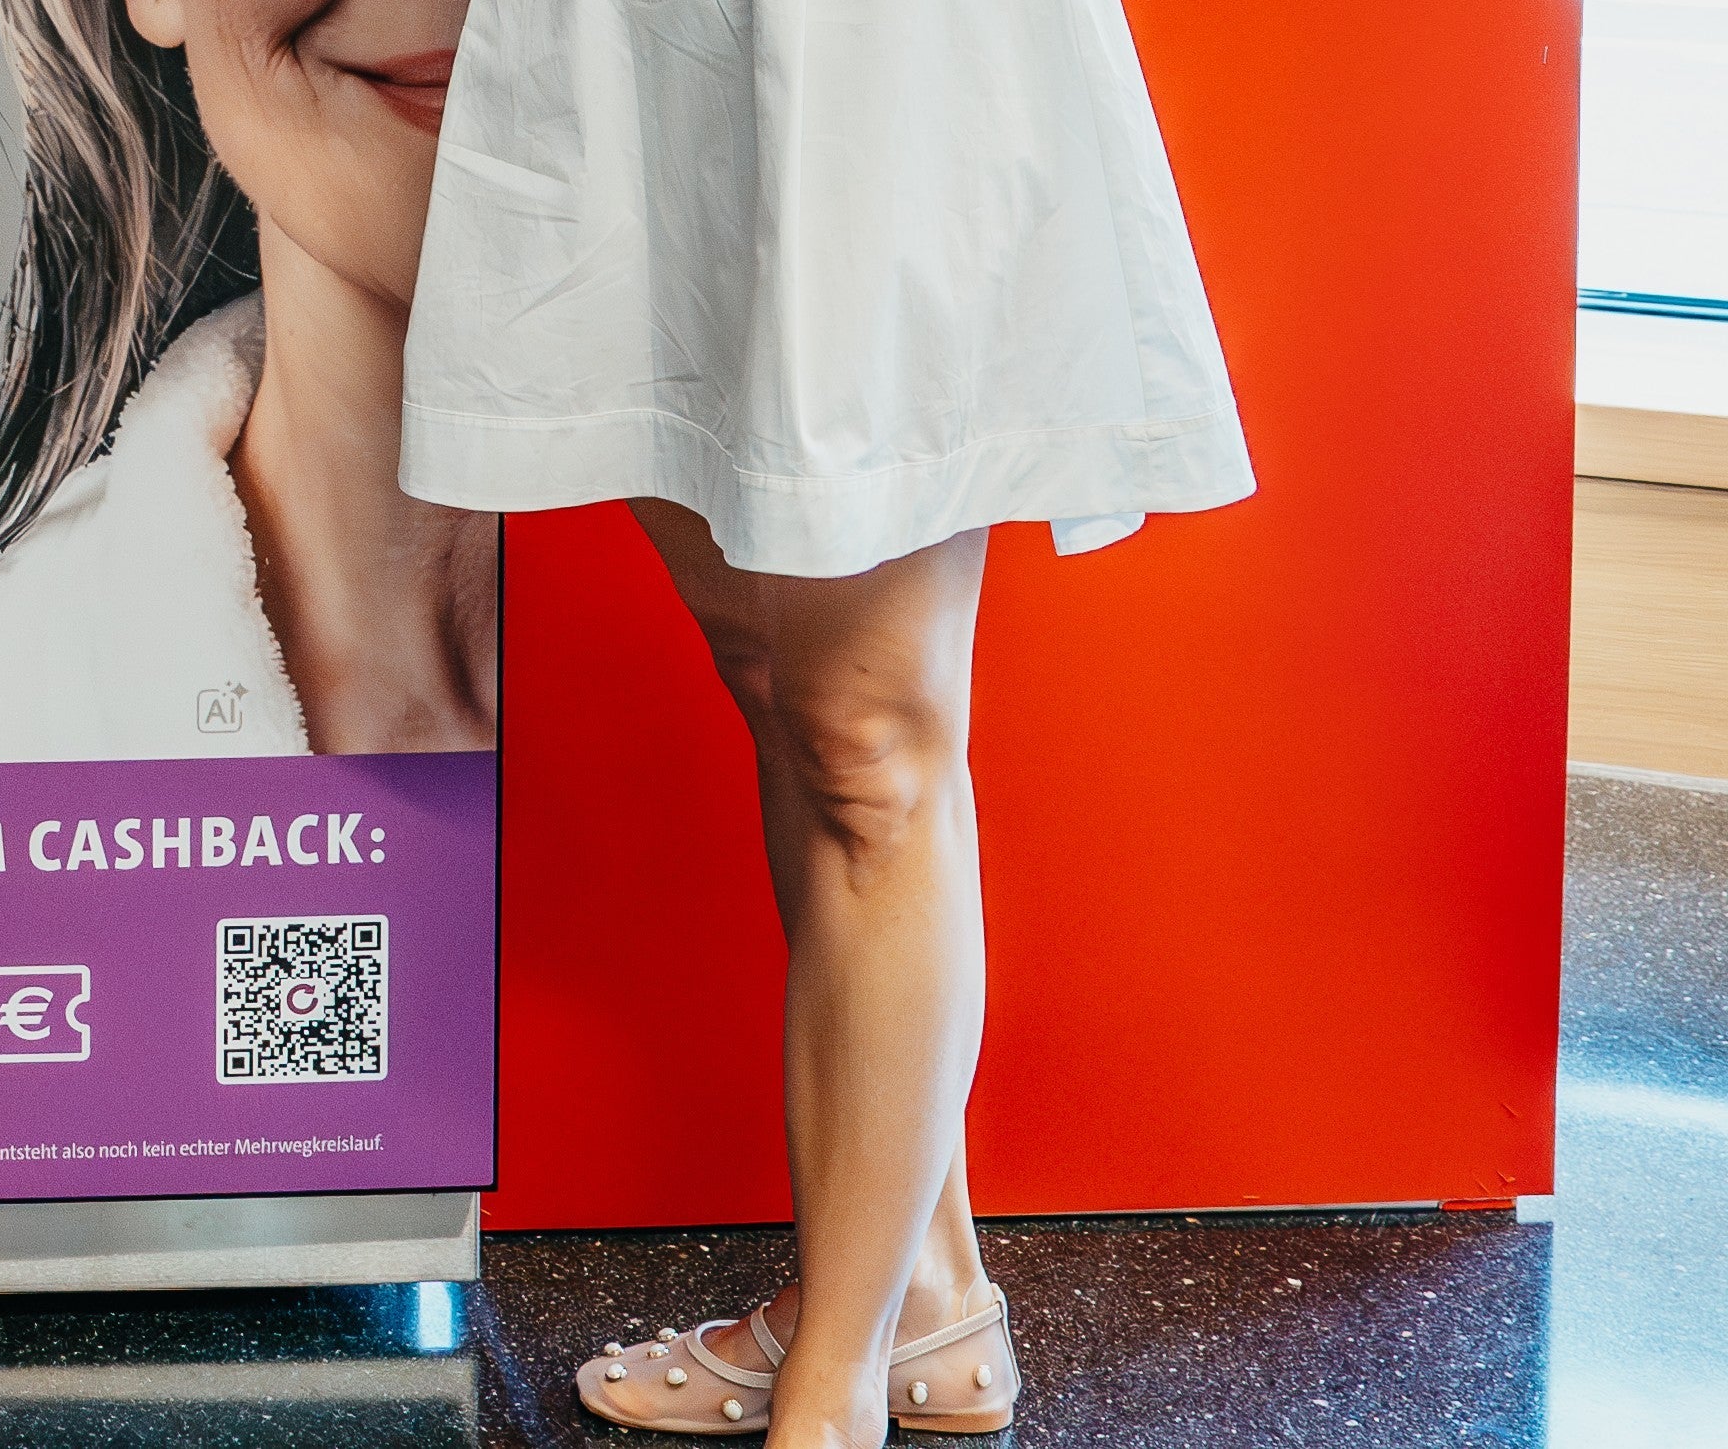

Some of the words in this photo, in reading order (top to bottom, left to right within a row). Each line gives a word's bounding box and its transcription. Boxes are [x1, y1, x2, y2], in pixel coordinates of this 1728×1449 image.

[27, 811, 388, 873] CASHBACK:
[62, 1140, 95, 1159] also
[98, 1139, 138, 1159] noch
[141, 1137, 176, 1158] kein
[179, 1135, 231, 1156] echter
[234, 1132, 385, 1159] Mehrwegkreislauf.
